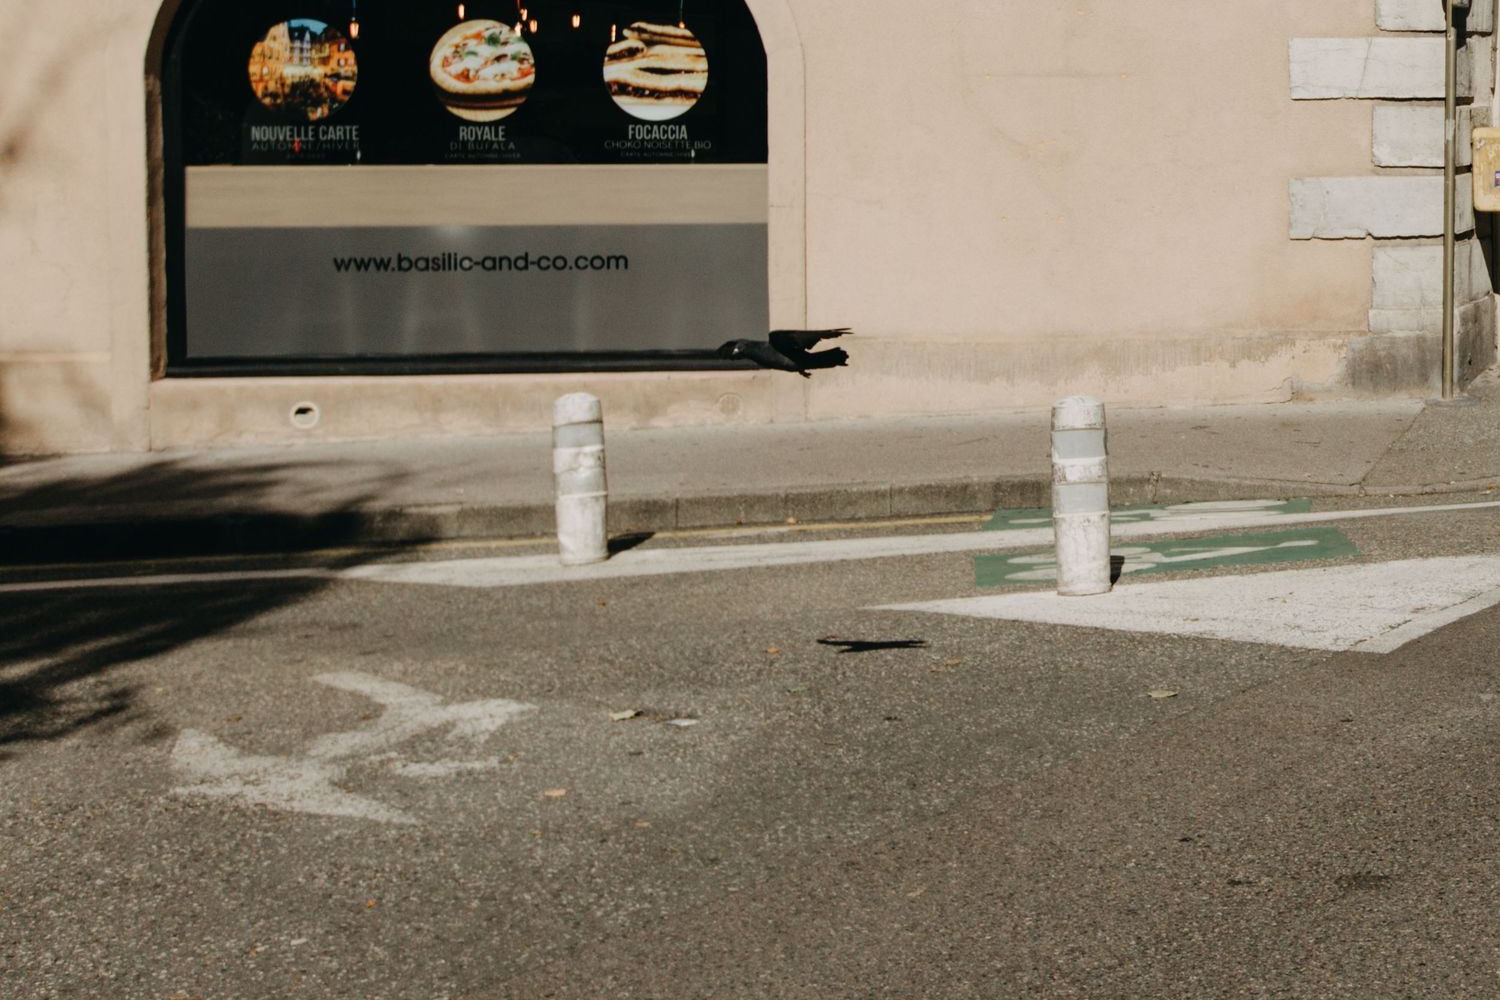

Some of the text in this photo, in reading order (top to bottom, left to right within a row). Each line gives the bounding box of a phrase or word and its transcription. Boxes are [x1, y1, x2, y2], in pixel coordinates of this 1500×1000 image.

[251, 125, 360, 141] NOUVELLE CARTE
[459, 125, 506, 141] ROYALE
[628, 124, 688, 140] FOCACCIA
[604, 140, 712, 150] CHOKO NOISETTE BIO
[333, 253, 629, 272] www.basilic-and-co.com
